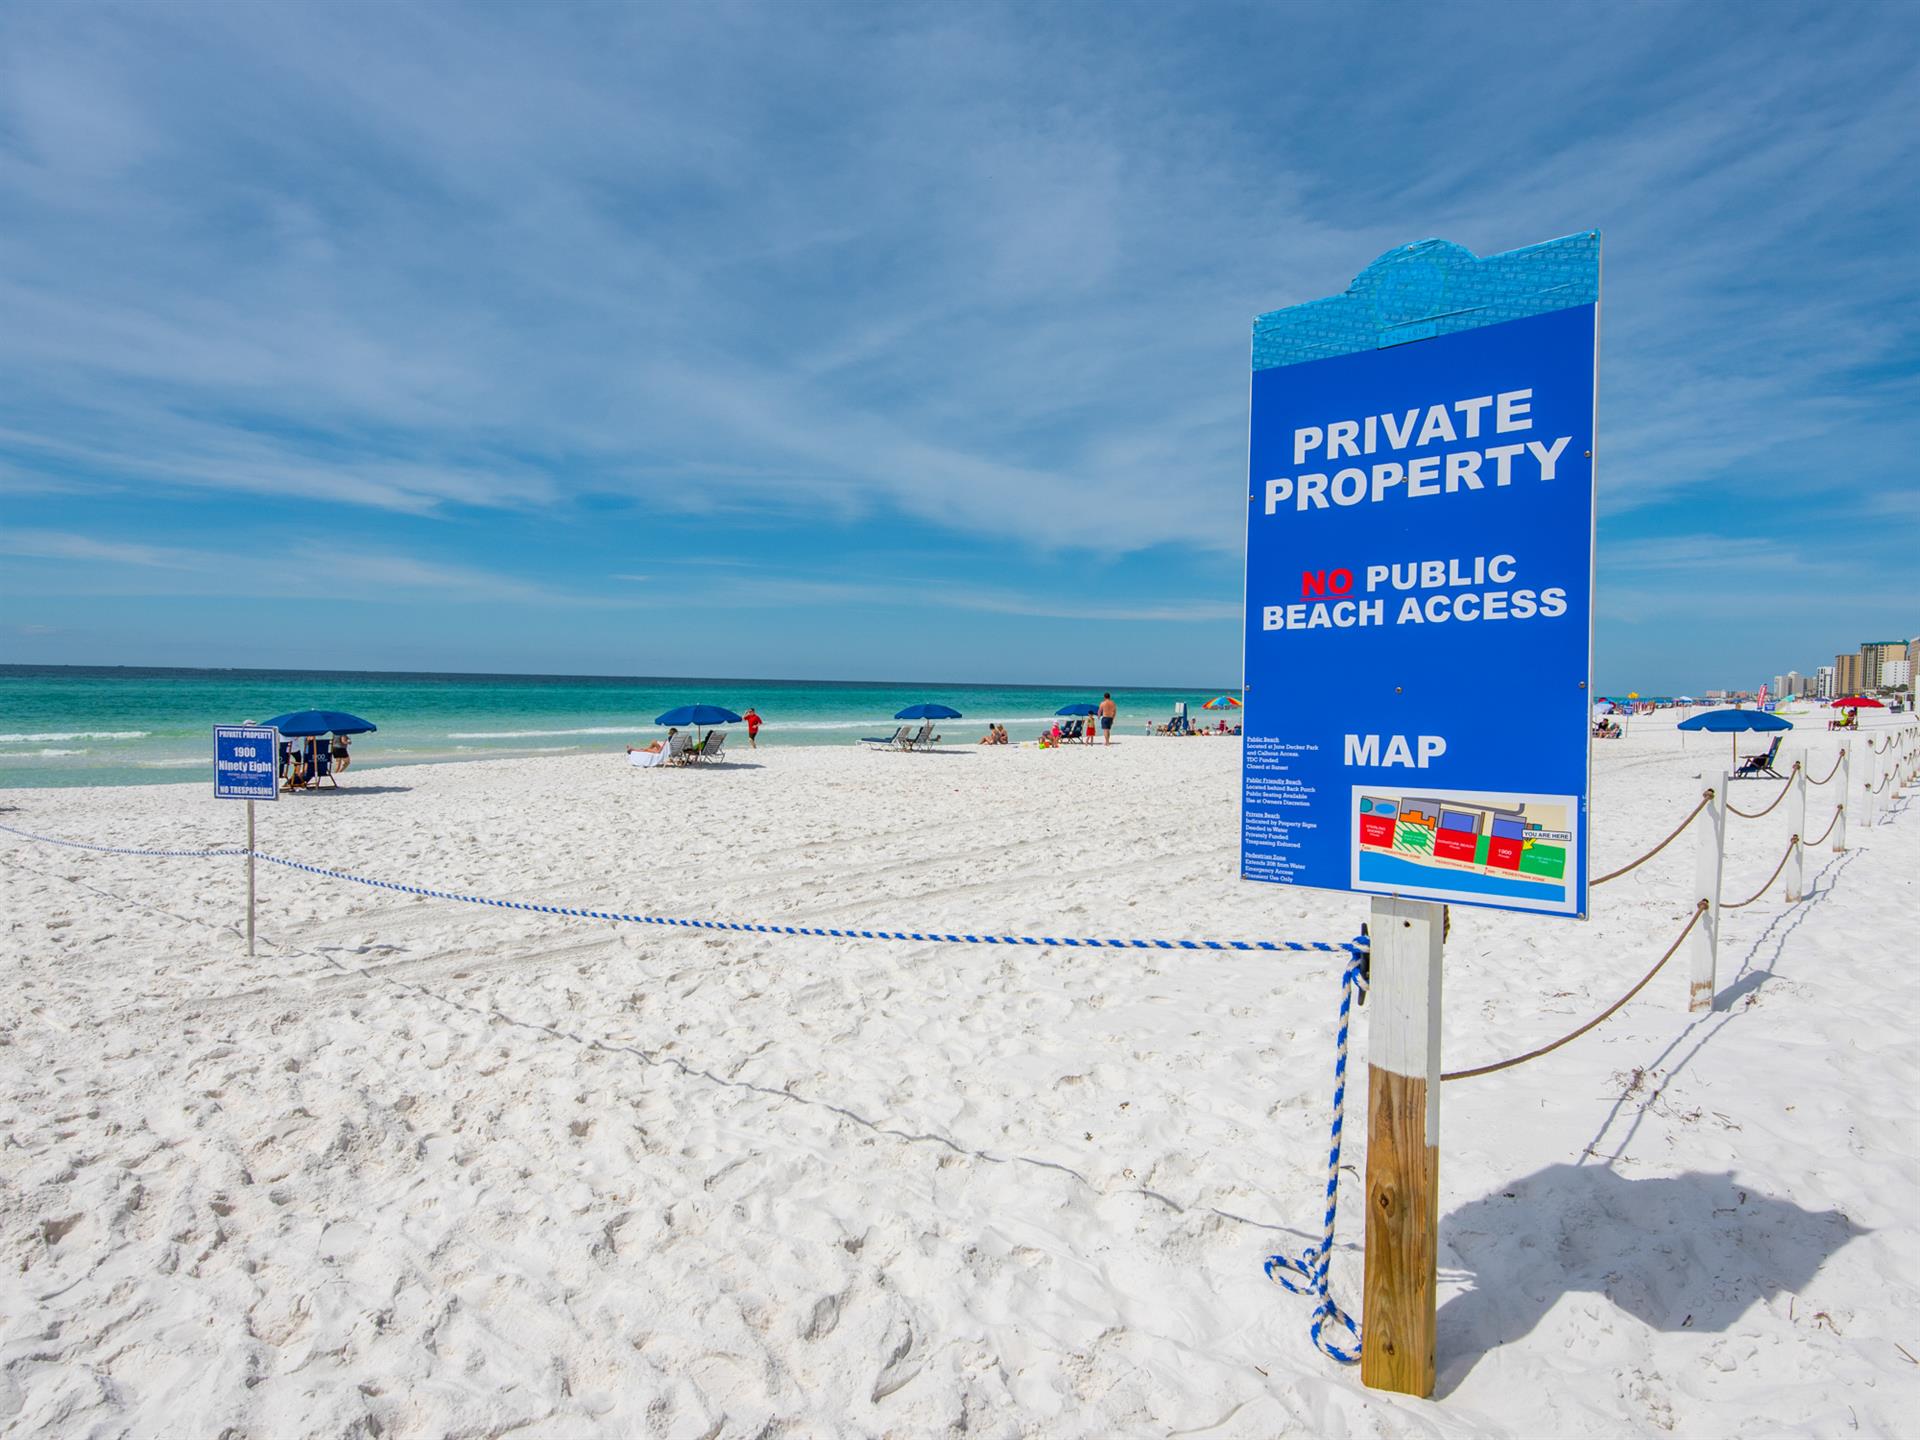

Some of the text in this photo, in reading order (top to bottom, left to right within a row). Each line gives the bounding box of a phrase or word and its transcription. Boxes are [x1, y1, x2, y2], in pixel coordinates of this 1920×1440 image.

[1293, 388, 1533, 465] PRIVATE
[1265, 436, 1573, 515] PROPERTY
[1301, 554, 1517, 598] NO PUBLIC
[1263, 587, 1568, 631] BEACH ACCESS
[219, 731, 272, 740] PRIVATE PROPERTY
[233, 746, 257, 758] 1900
[1344, 734, 1447, 769] MAP
[219, 760, 272, 773] Ninety Eight
[220, 786, 273, 795] NO TRESPASSING
